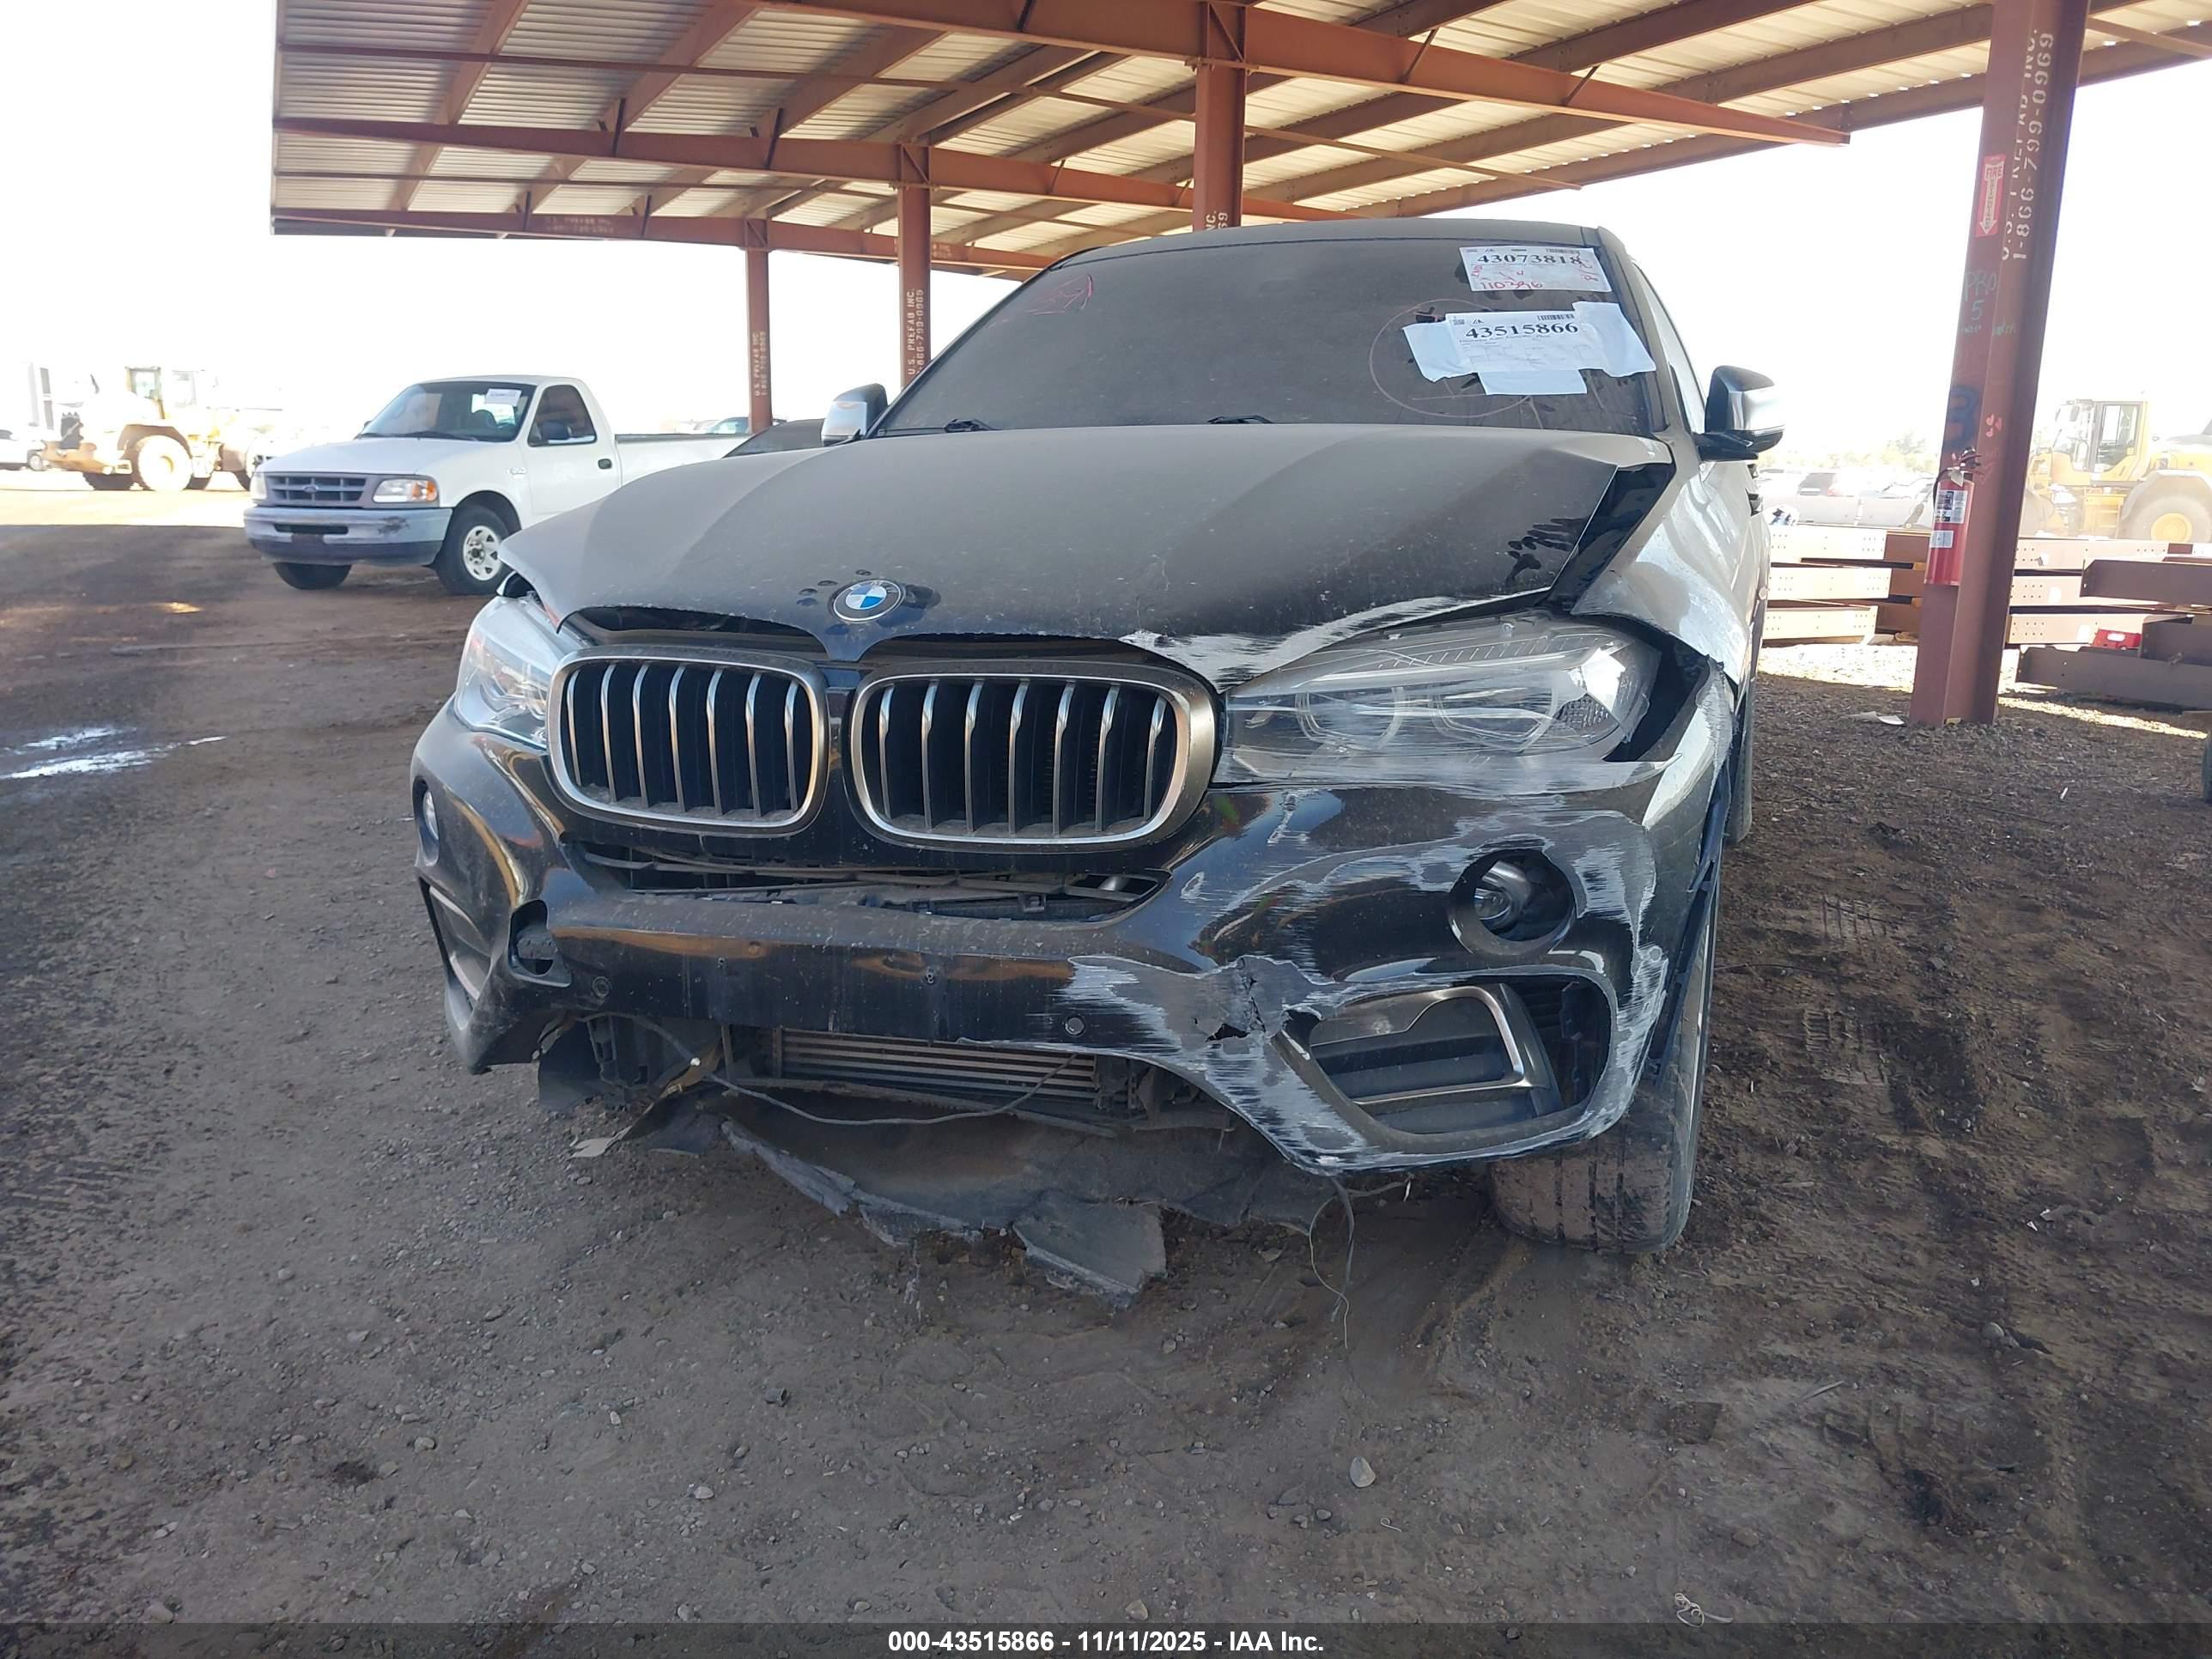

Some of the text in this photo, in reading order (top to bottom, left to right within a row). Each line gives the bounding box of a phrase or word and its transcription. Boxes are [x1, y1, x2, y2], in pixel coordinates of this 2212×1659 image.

[2013, 33, 2054, 259] 1-866-799-0969
[1478, 254, 1582, 264] 43073818
[1465, 322, 1579, 339] 43515866
